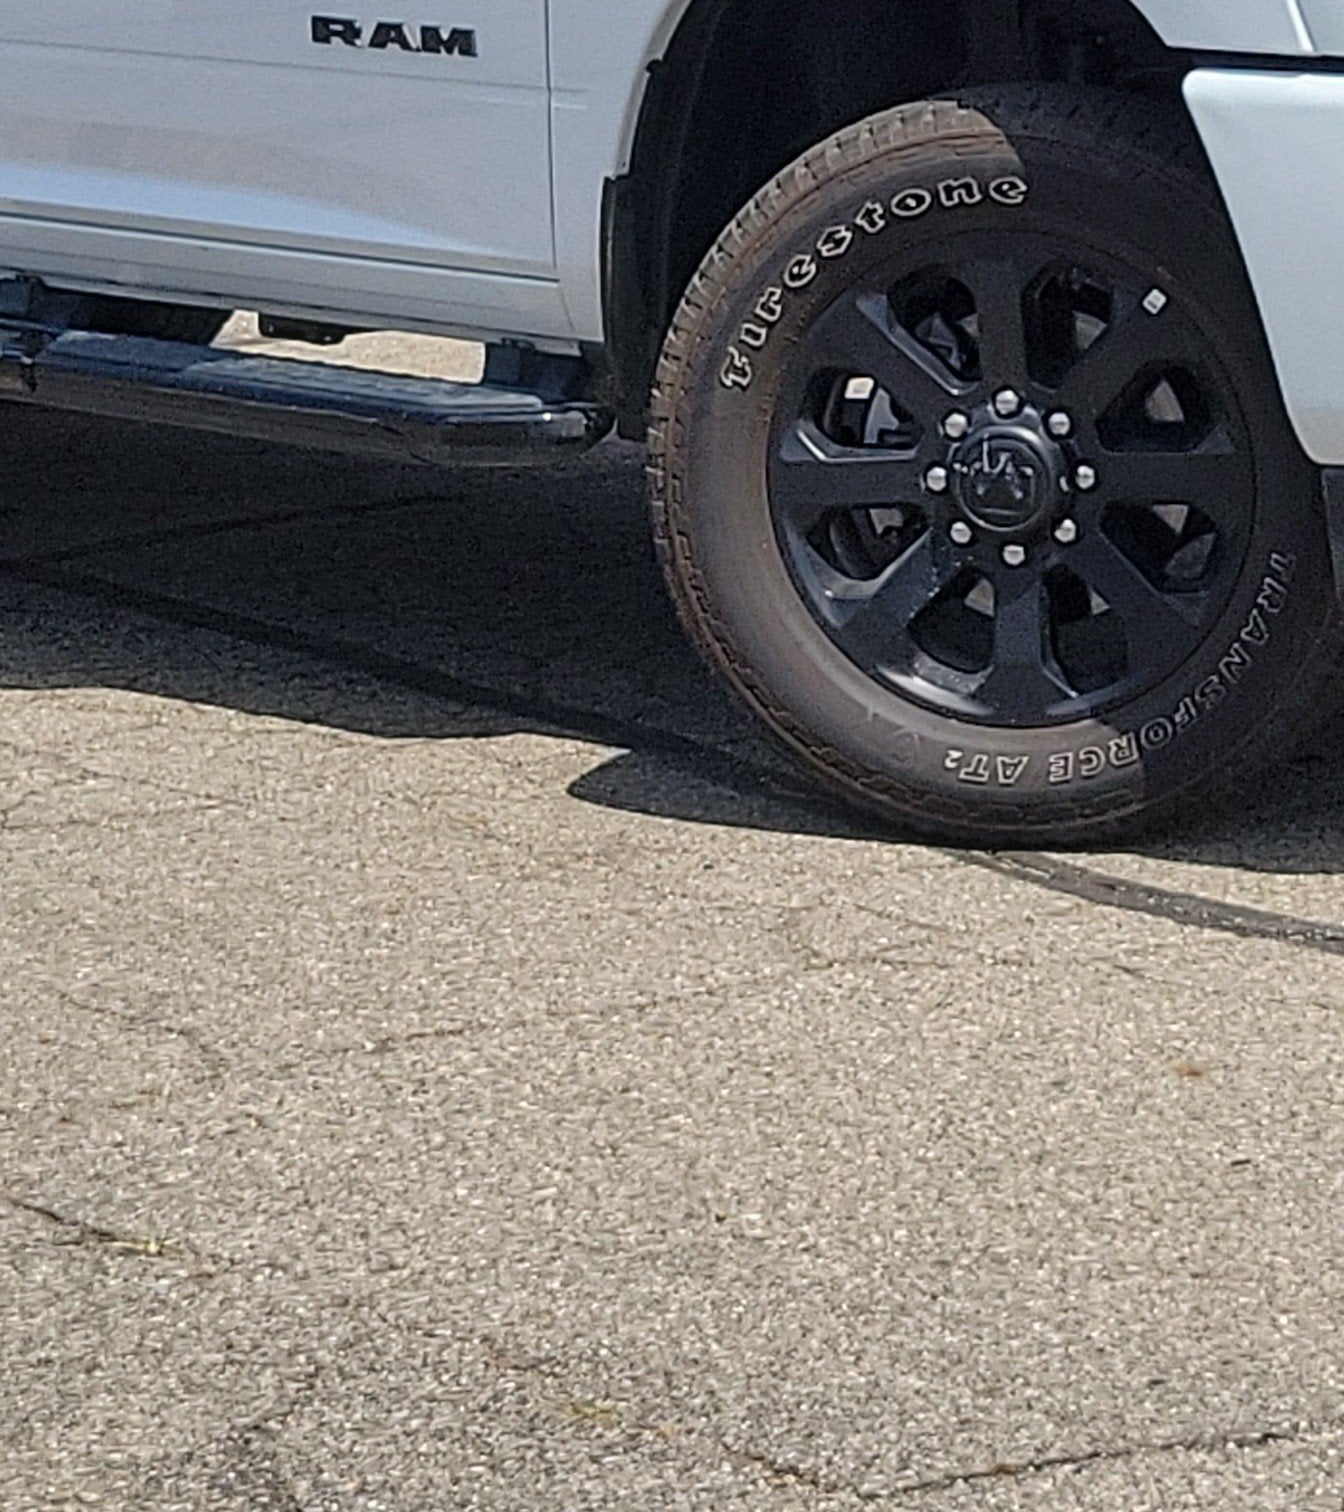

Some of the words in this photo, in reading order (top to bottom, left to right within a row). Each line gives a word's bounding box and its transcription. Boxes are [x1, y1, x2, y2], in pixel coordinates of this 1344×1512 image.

[311, 15, 478, 57] RAM
[719, 175, 1028, 388] Firestone
[1048, 551, 1297, 783] TRANSFORCE
